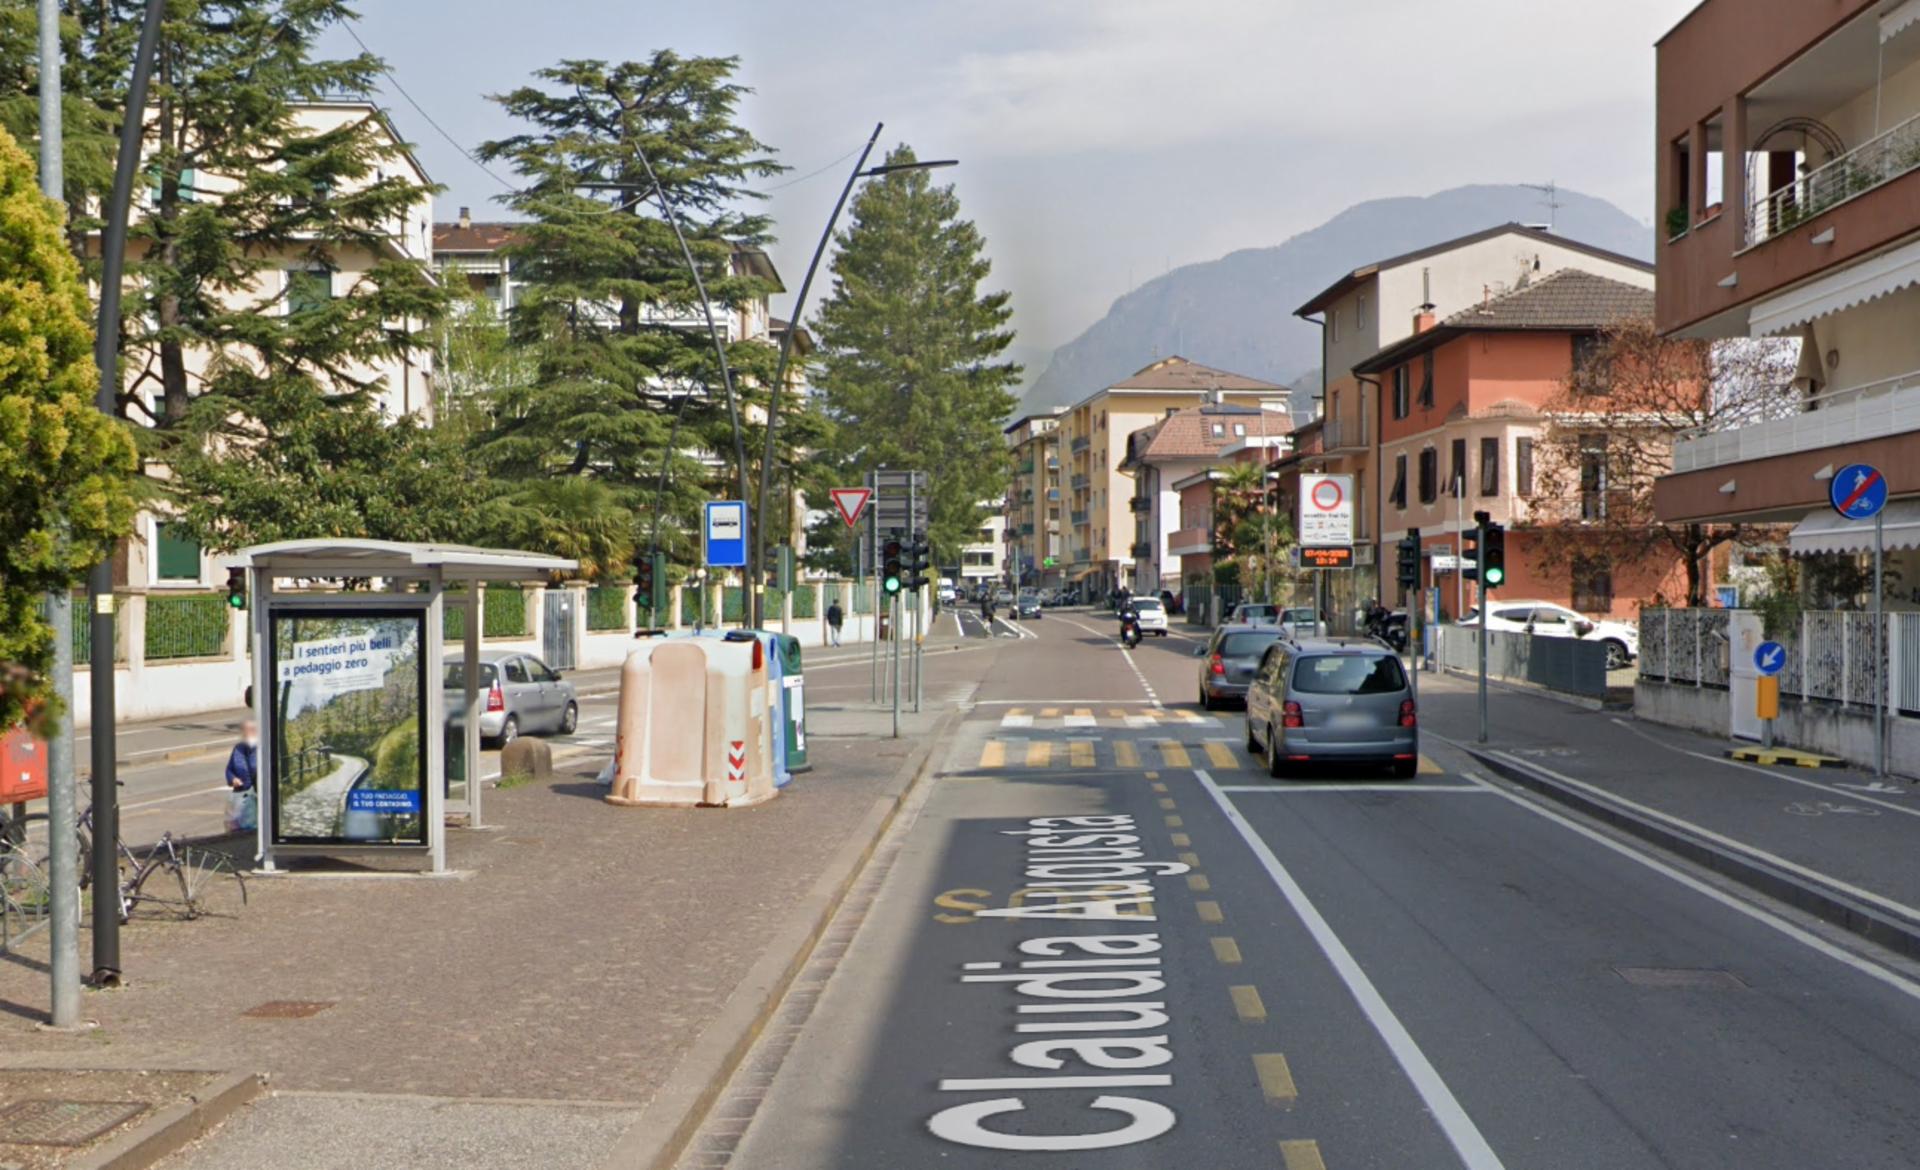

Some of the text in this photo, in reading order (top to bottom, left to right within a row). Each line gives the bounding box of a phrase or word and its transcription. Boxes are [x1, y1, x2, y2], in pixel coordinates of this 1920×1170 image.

[299, 636, 391, 657] I sentieri più belli
[283, 658, 368, 676] a pedaggio zero
[927, 814, 1190, 1151] Claudia Augusta
